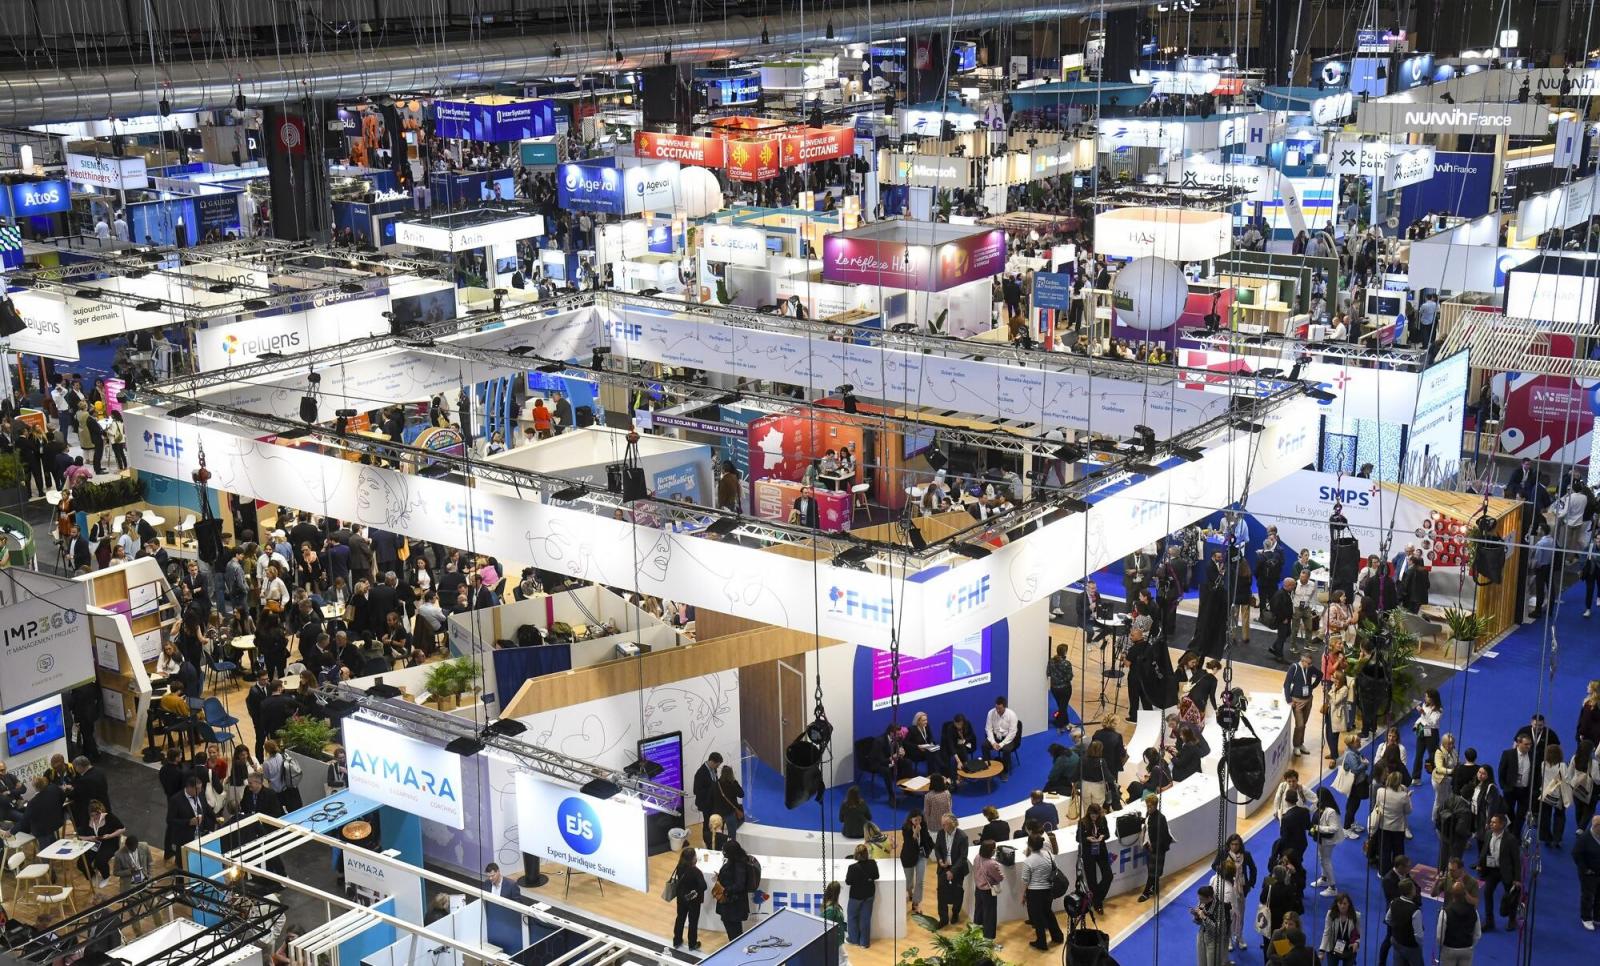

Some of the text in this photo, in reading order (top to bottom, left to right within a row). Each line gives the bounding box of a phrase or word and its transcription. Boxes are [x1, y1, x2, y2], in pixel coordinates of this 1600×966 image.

[1469, 113, 1511, 126] France
[1251, 128, 1263, 142] H
[656, 138, 689, 149] BIENVENUE
[800, 137, 827, 148] BIENVENUE
[656, 147, 704, 160] OCCITANIE
[799, 143, 839, 159] OCCITANIE
[81, 160, 110, 172] SIEMENS
[914, 165, 957, 178] Microsoft
[1454, 166, 1477, 174] France
[70, 169, 111, 183] Healthineers
[1129, 231, 1156, 243] HAS
[835, 252, 849, 265] Le
[73, 303, 113, 316] aujourd'hui
[91, 312, 120, 323] demain.
[23, 317, 60, 335] relyens
[615, 321, 642, 341] FHF
[242, 332, 300, 355] relyens
[154, 432, 184, 459] FHF
[1319, 485, 1370, 506] SMPS
[1295, 505, 1306, 513] Le
[457, 503, 494, 533] FHF
[1311, 531, 1323, 540] de
[958, 574, 990, 614] FHF
[846, 589, 893, 623] FHF
[13, 637, 54, 654] MANAGEMENT
[54, 625, 80, 640] PROJECT
[350, 748, 456, 802] AYMARA
[547, 846, 616, 877] Expert Juridique Santé
[1120, 845, 1150, 874] FH
[347, 857, 384, 877] AYMARA
